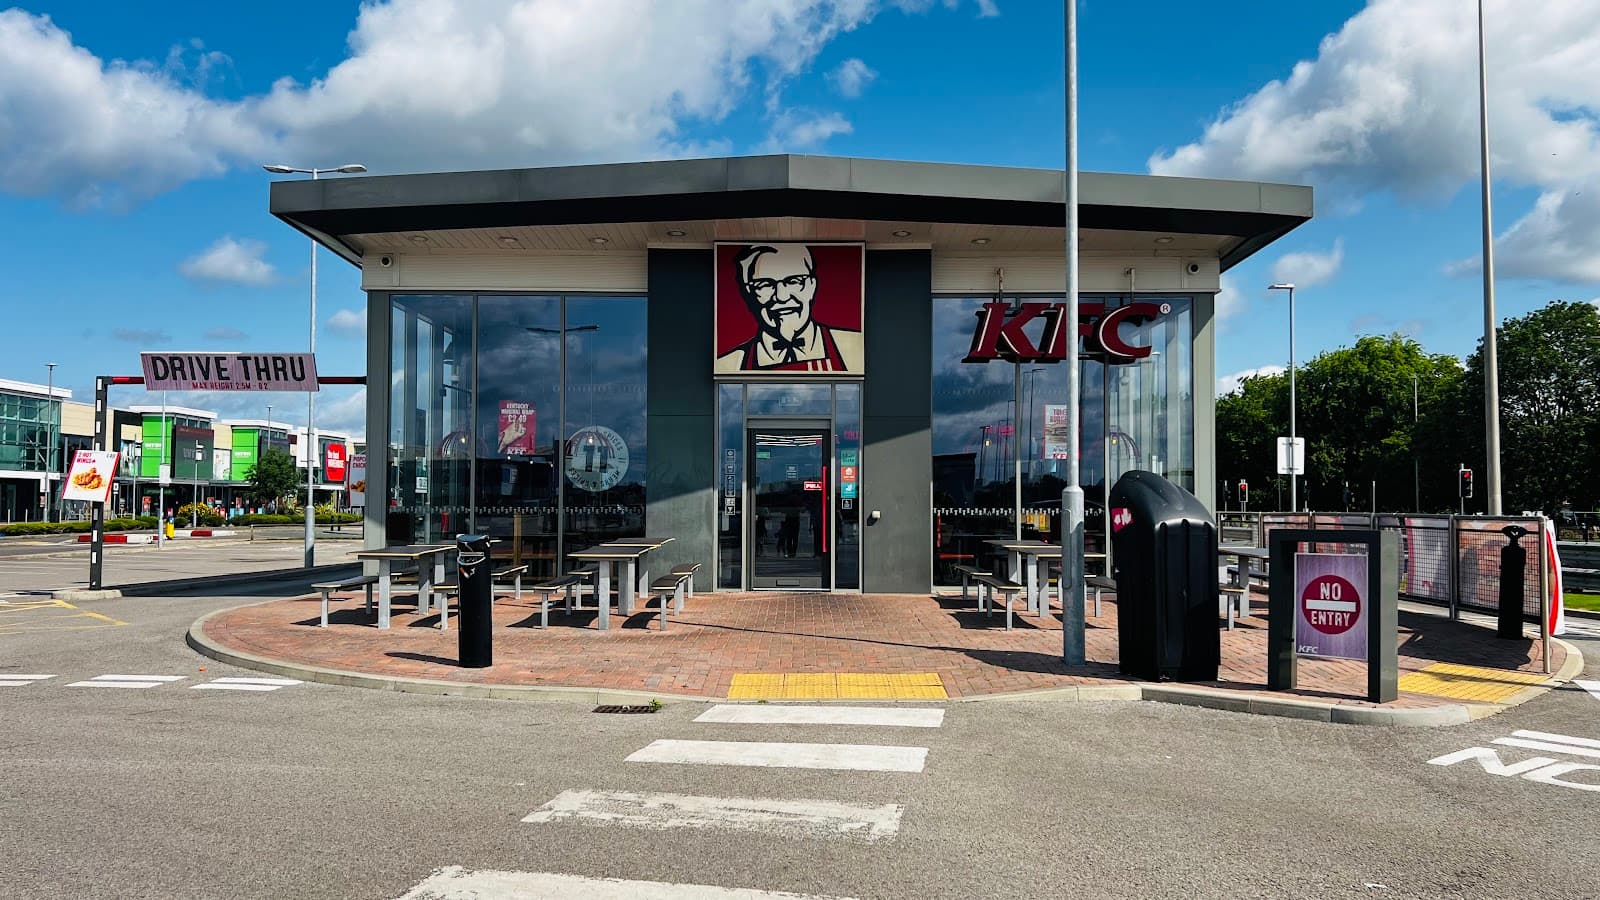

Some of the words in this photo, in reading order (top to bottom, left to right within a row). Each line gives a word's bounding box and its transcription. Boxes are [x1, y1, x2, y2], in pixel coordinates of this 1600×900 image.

[964, 302, 1159, 362] KFC
[151, 356, 231, 381] DRIVE
[237, 356, 306, 381] THRU
[192, 382, 208, 390] MAX
[210, 382, 233, 390] HEIGHT
[1320, 582, 1342, 600] NO
[1311, 611, 1351, 627] ENTRY
[1298, 645, 1318, 654] KFC
